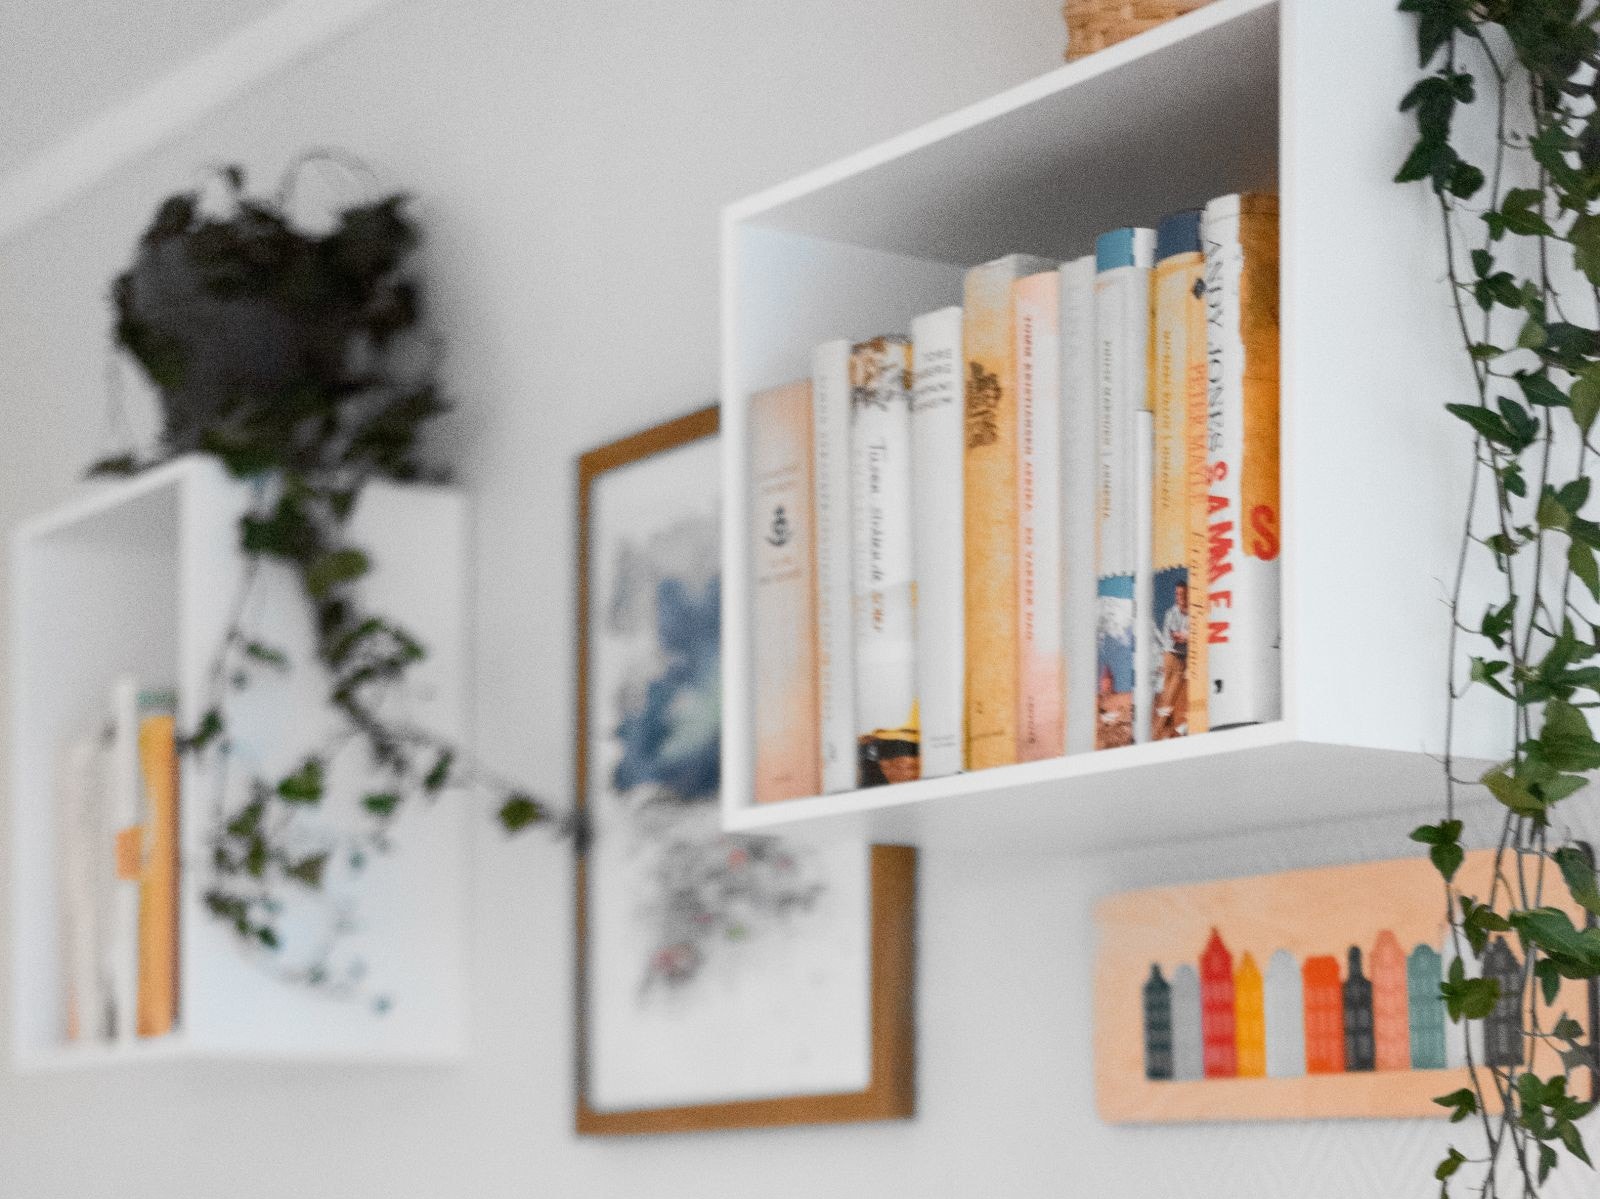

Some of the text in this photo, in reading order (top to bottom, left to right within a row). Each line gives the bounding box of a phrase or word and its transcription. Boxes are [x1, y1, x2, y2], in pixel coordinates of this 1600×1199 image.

[1188, 362, 1207, 427] PETER
[1206, 240, 1225, 452] ANDY JONES
